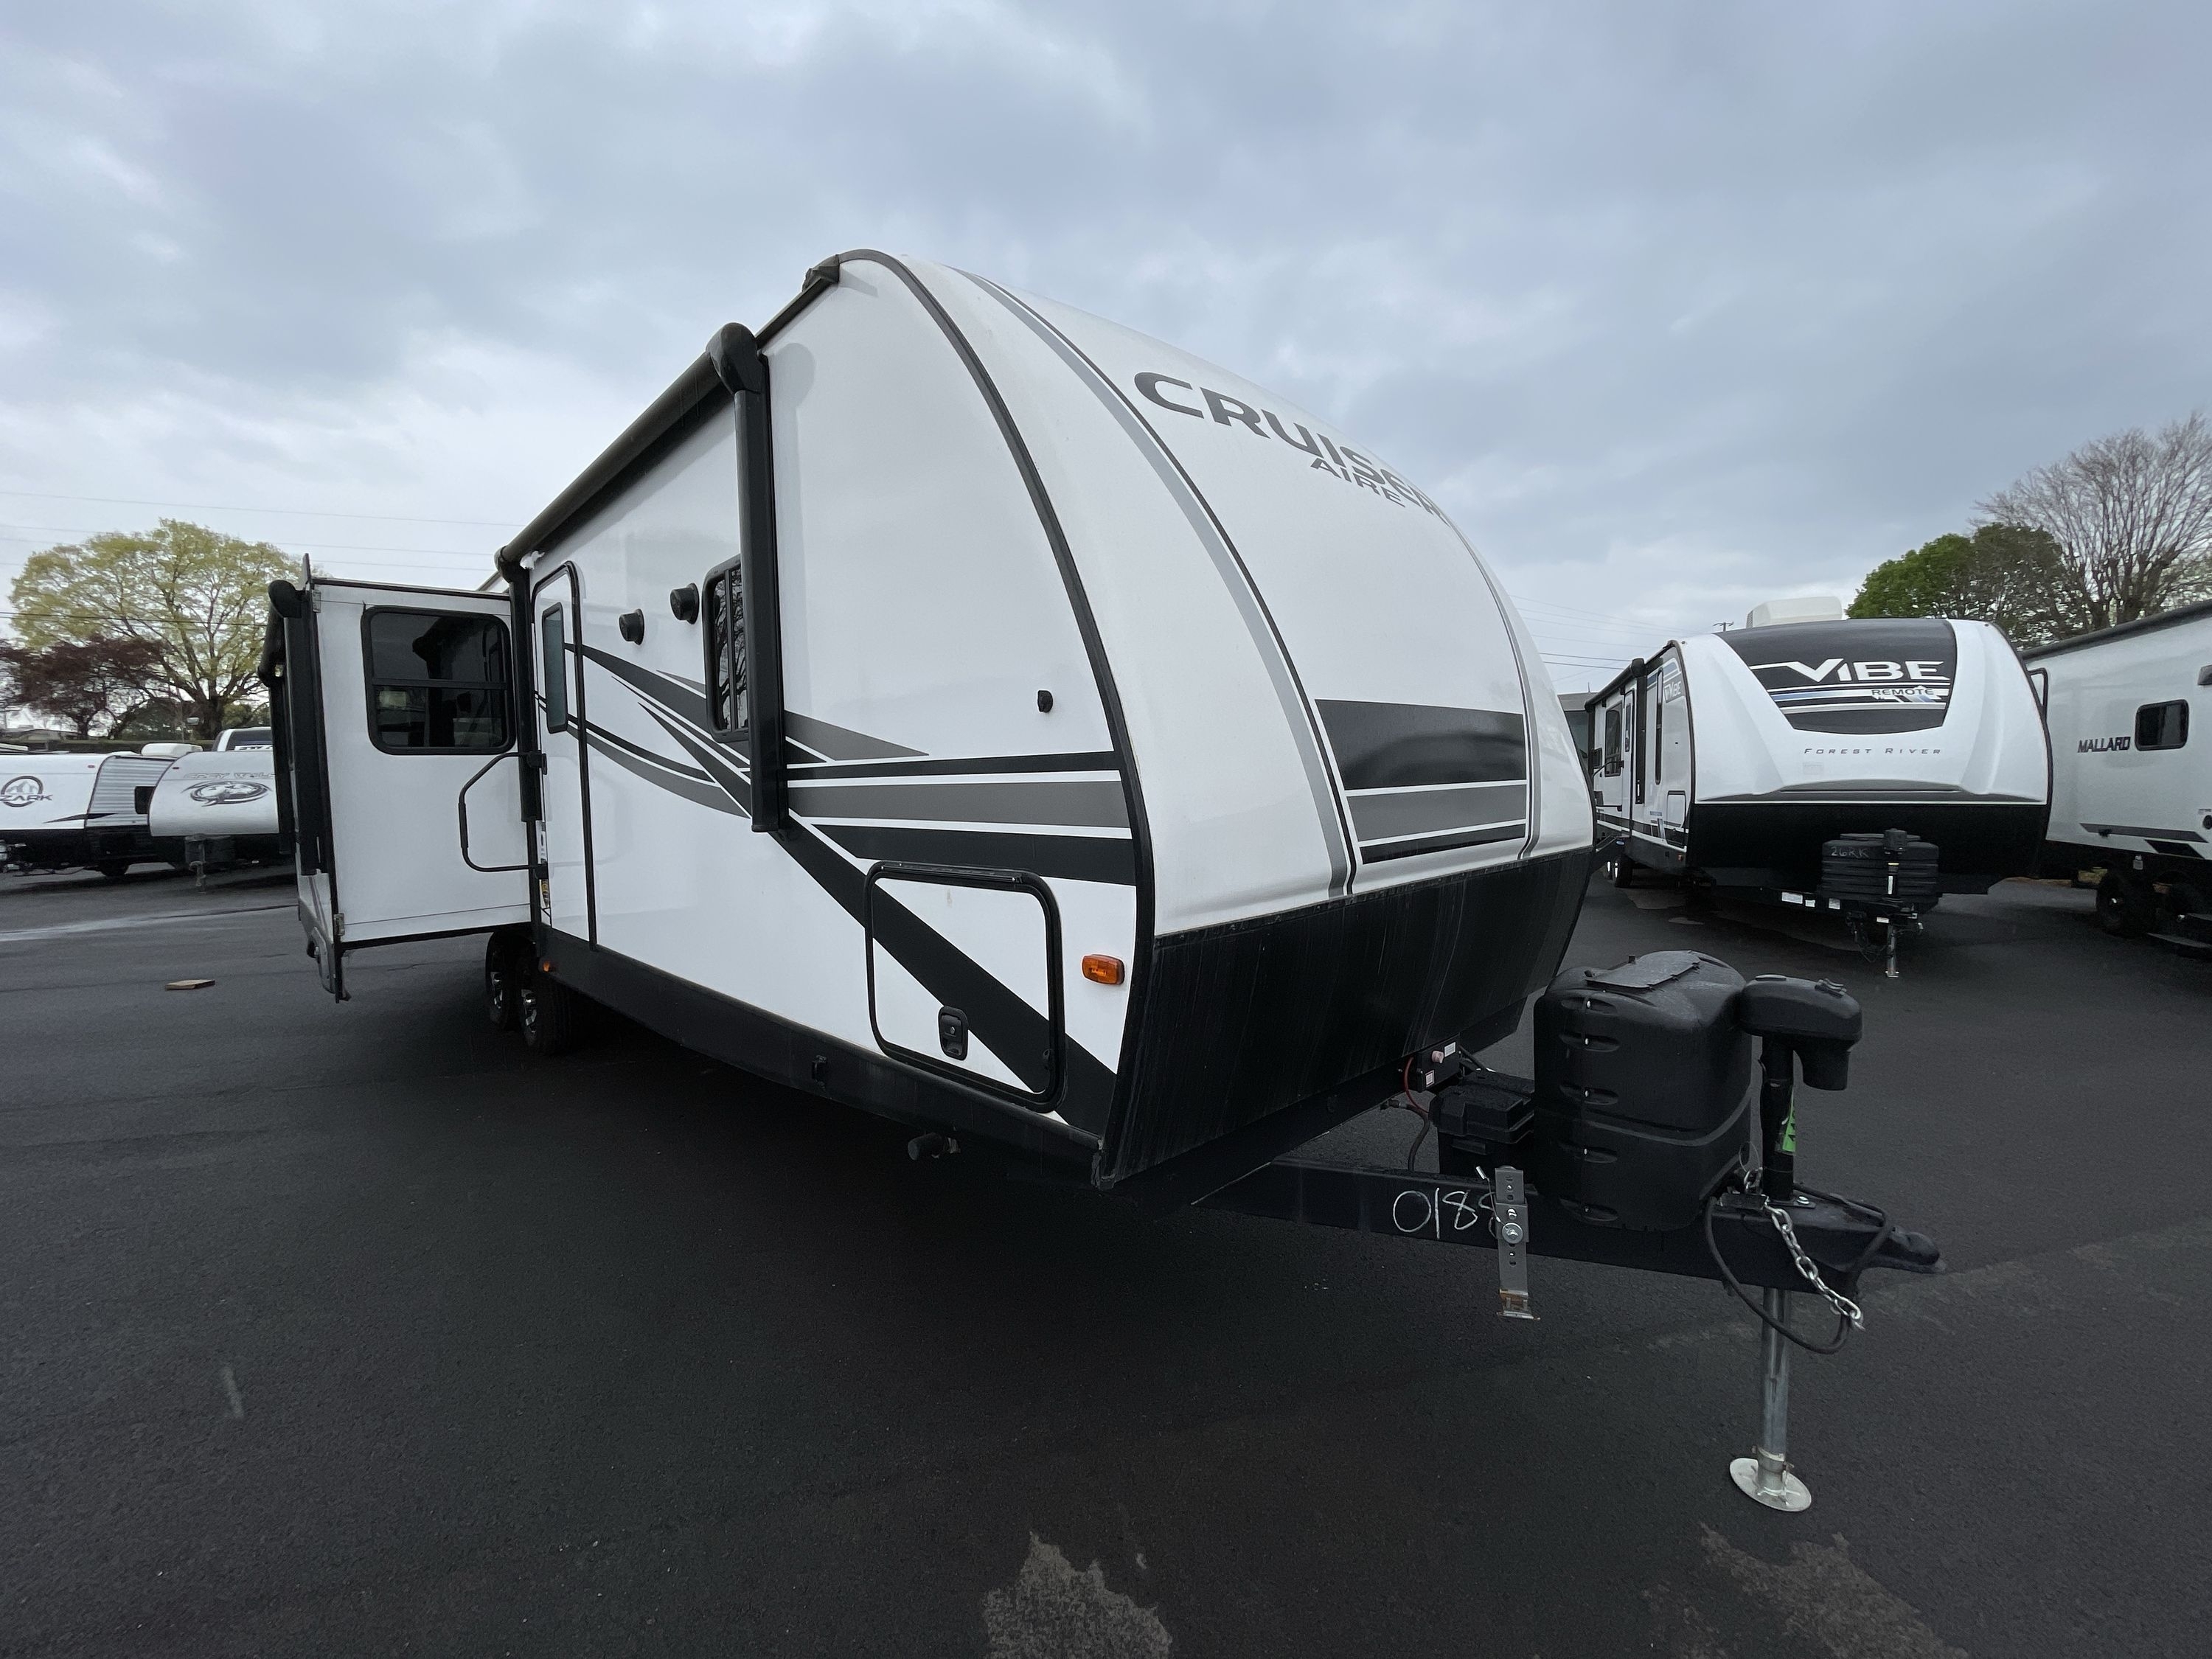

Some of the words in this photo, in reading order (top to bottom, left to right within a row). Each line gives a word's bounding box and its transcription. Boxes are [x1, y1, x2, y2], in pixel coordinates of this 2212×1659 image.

[1134, 372, 1450, 528] CRUISER
[1310, 458, 1405, 508] AIRE
[1777, 658, 1950, 683] VIBE
[2077, 737, 2131, 753] MALLARD
[1830, 846, 1870, 859] 26RK
